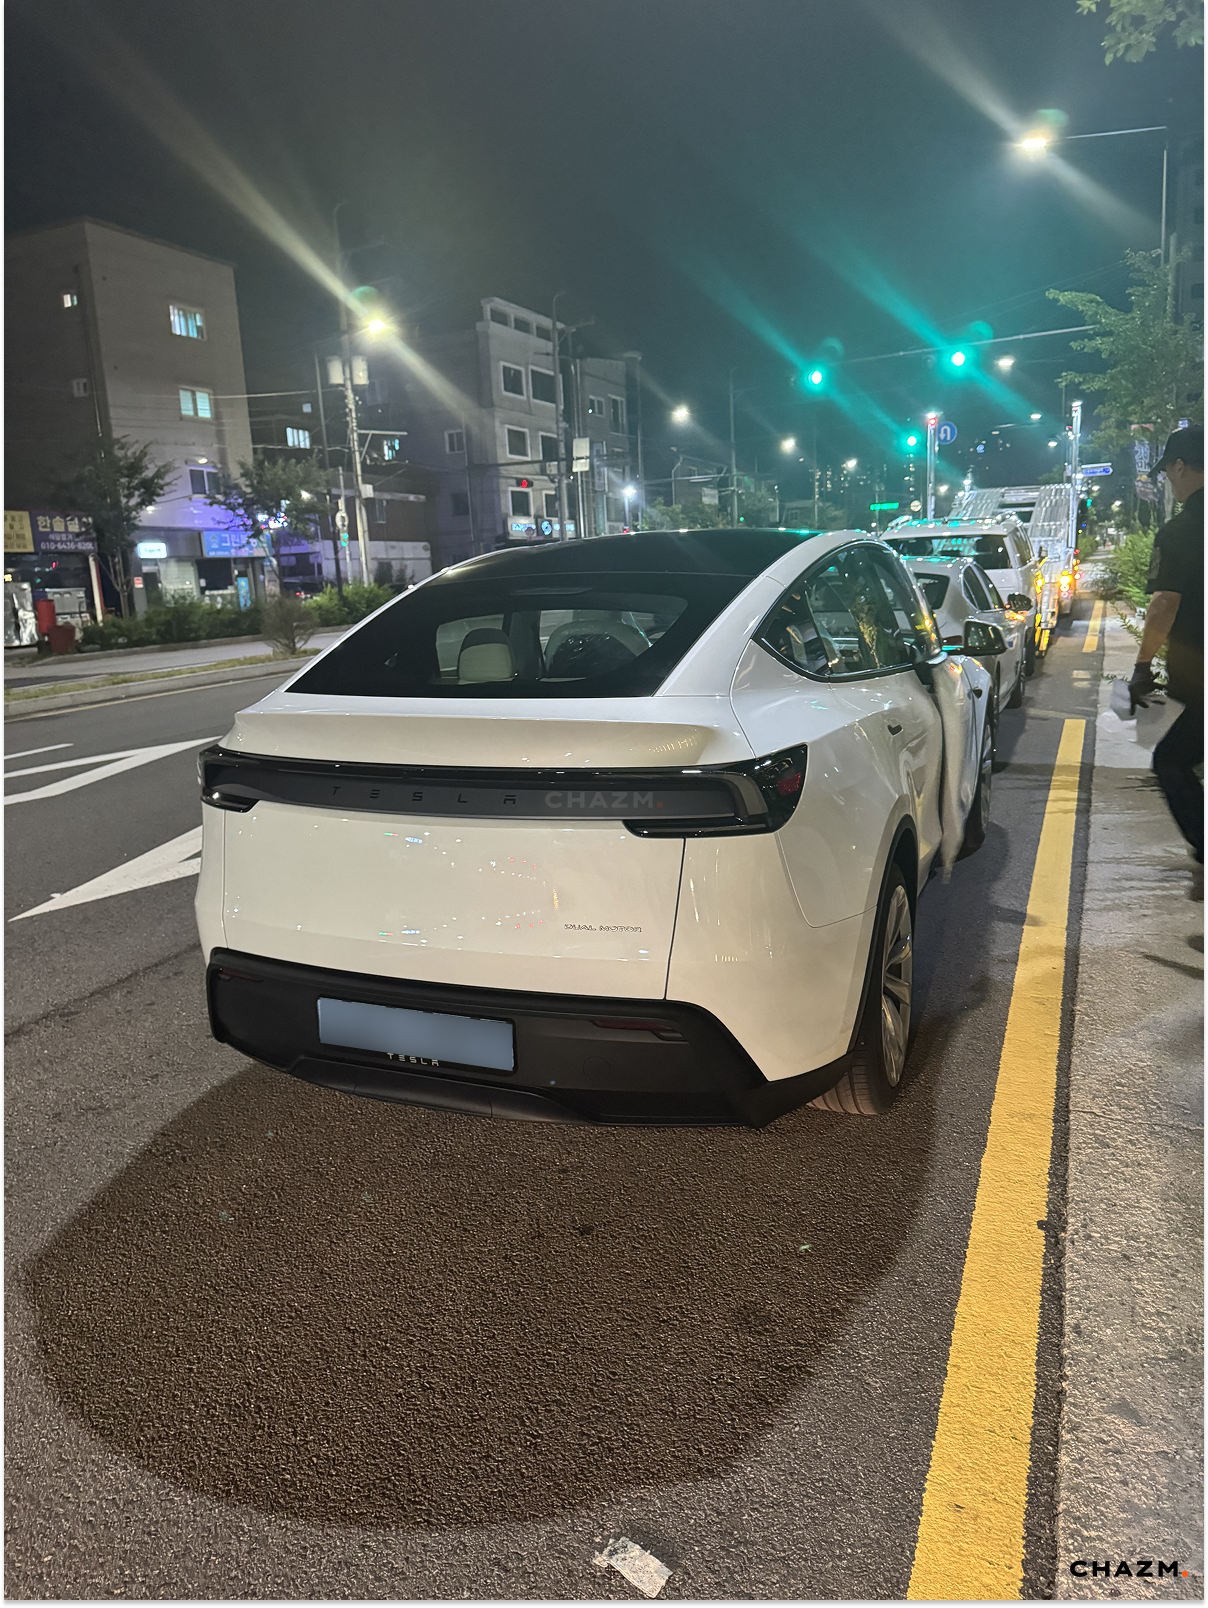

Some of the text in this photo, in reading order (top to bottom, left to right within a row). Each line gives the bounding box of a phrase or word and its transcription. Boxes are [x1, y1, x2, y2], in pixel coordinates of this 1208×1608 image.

[332, 786, 517, 805] TESLA
[564, 923, 643, 934] DUAL MOTOR
[386, 1052, 440, 1067] TESLA
